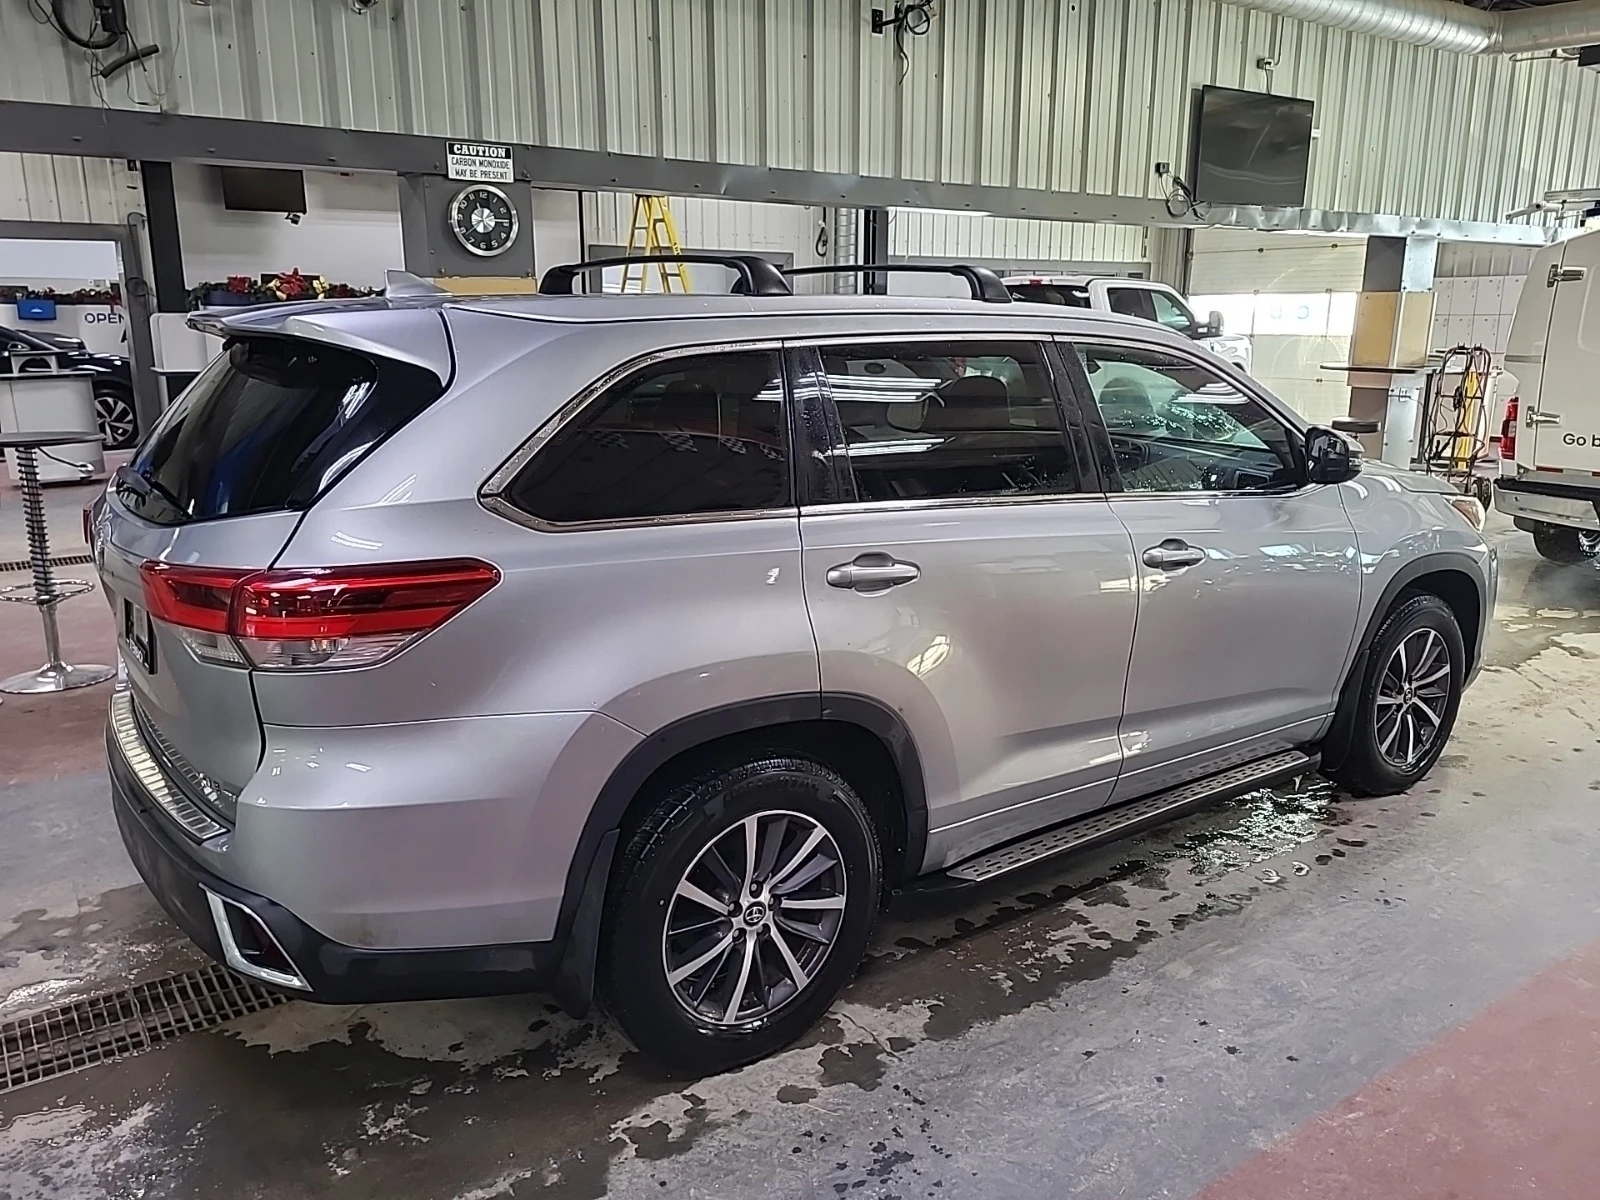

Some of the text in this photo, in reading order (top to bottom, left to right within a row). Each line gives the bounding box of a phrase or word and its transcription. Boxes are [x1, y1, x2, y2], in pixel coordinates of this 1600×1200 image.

[453, 144, 507, 158] CAUTION
[451, 157, 510, 169] CARBON MONOXIDE
[455, 168, 507, 180] MAY BE PRESENT
[479, 191, 488, 199] 12
[459, 200, 468, 210] 10
[491, 240, 498, 248] 5
[1563, 433, 1587, 446] Go
